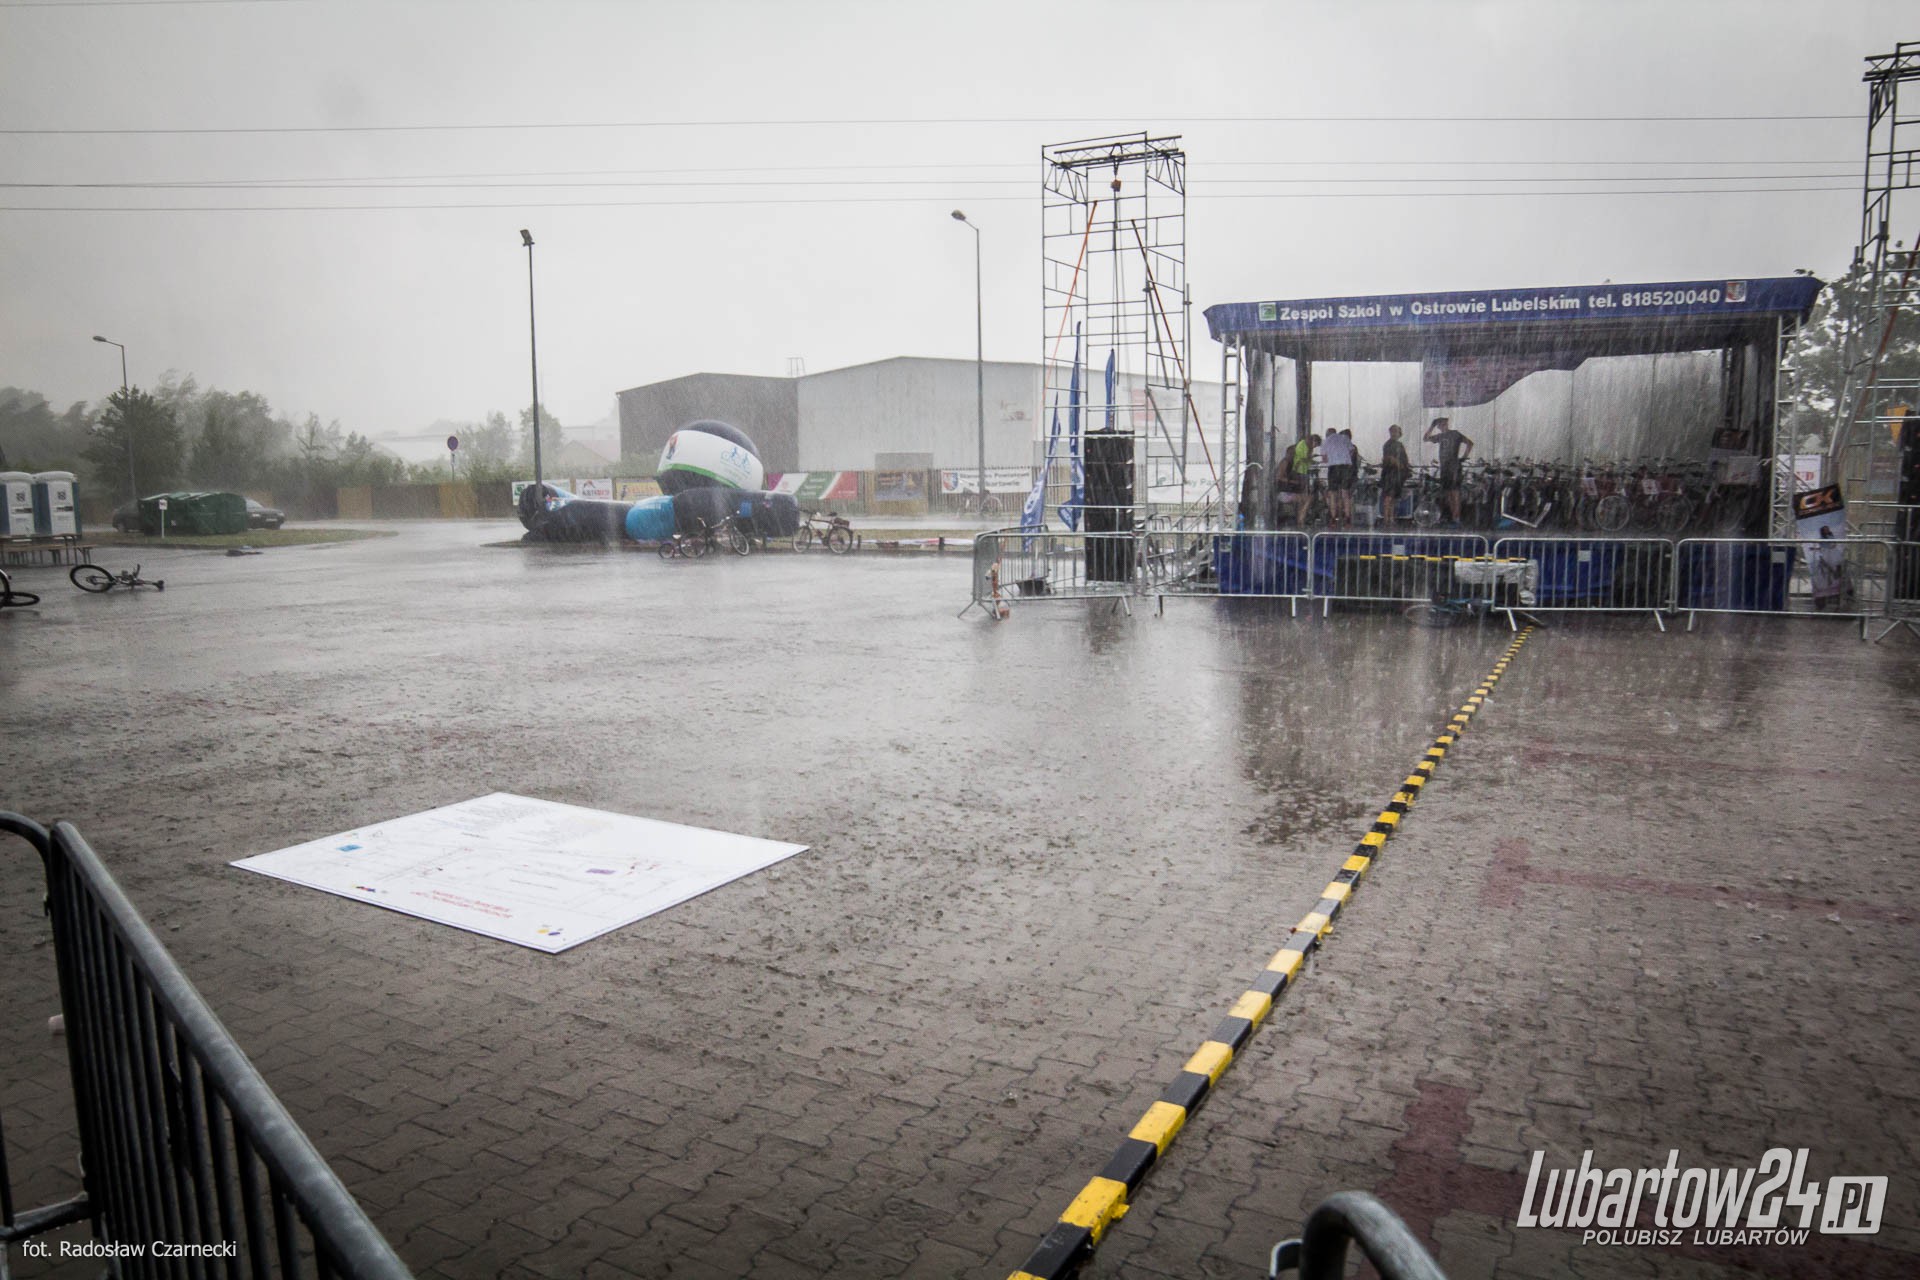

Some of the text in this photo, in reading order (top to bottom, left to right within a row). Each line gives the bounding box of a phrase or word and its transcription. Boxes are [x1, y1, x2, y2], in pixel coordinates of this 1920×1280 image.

[1338, 302, 1381, 319] Szkół
[1389, 304, 1404, 316] w
[1411, 298, 1487, 316] Ostrowie
[1491, 294, 1580, 313] Lubelskim
[1588, 297, 1617, 309] tel.
[1621, 289, 1721, 307] 818520040
